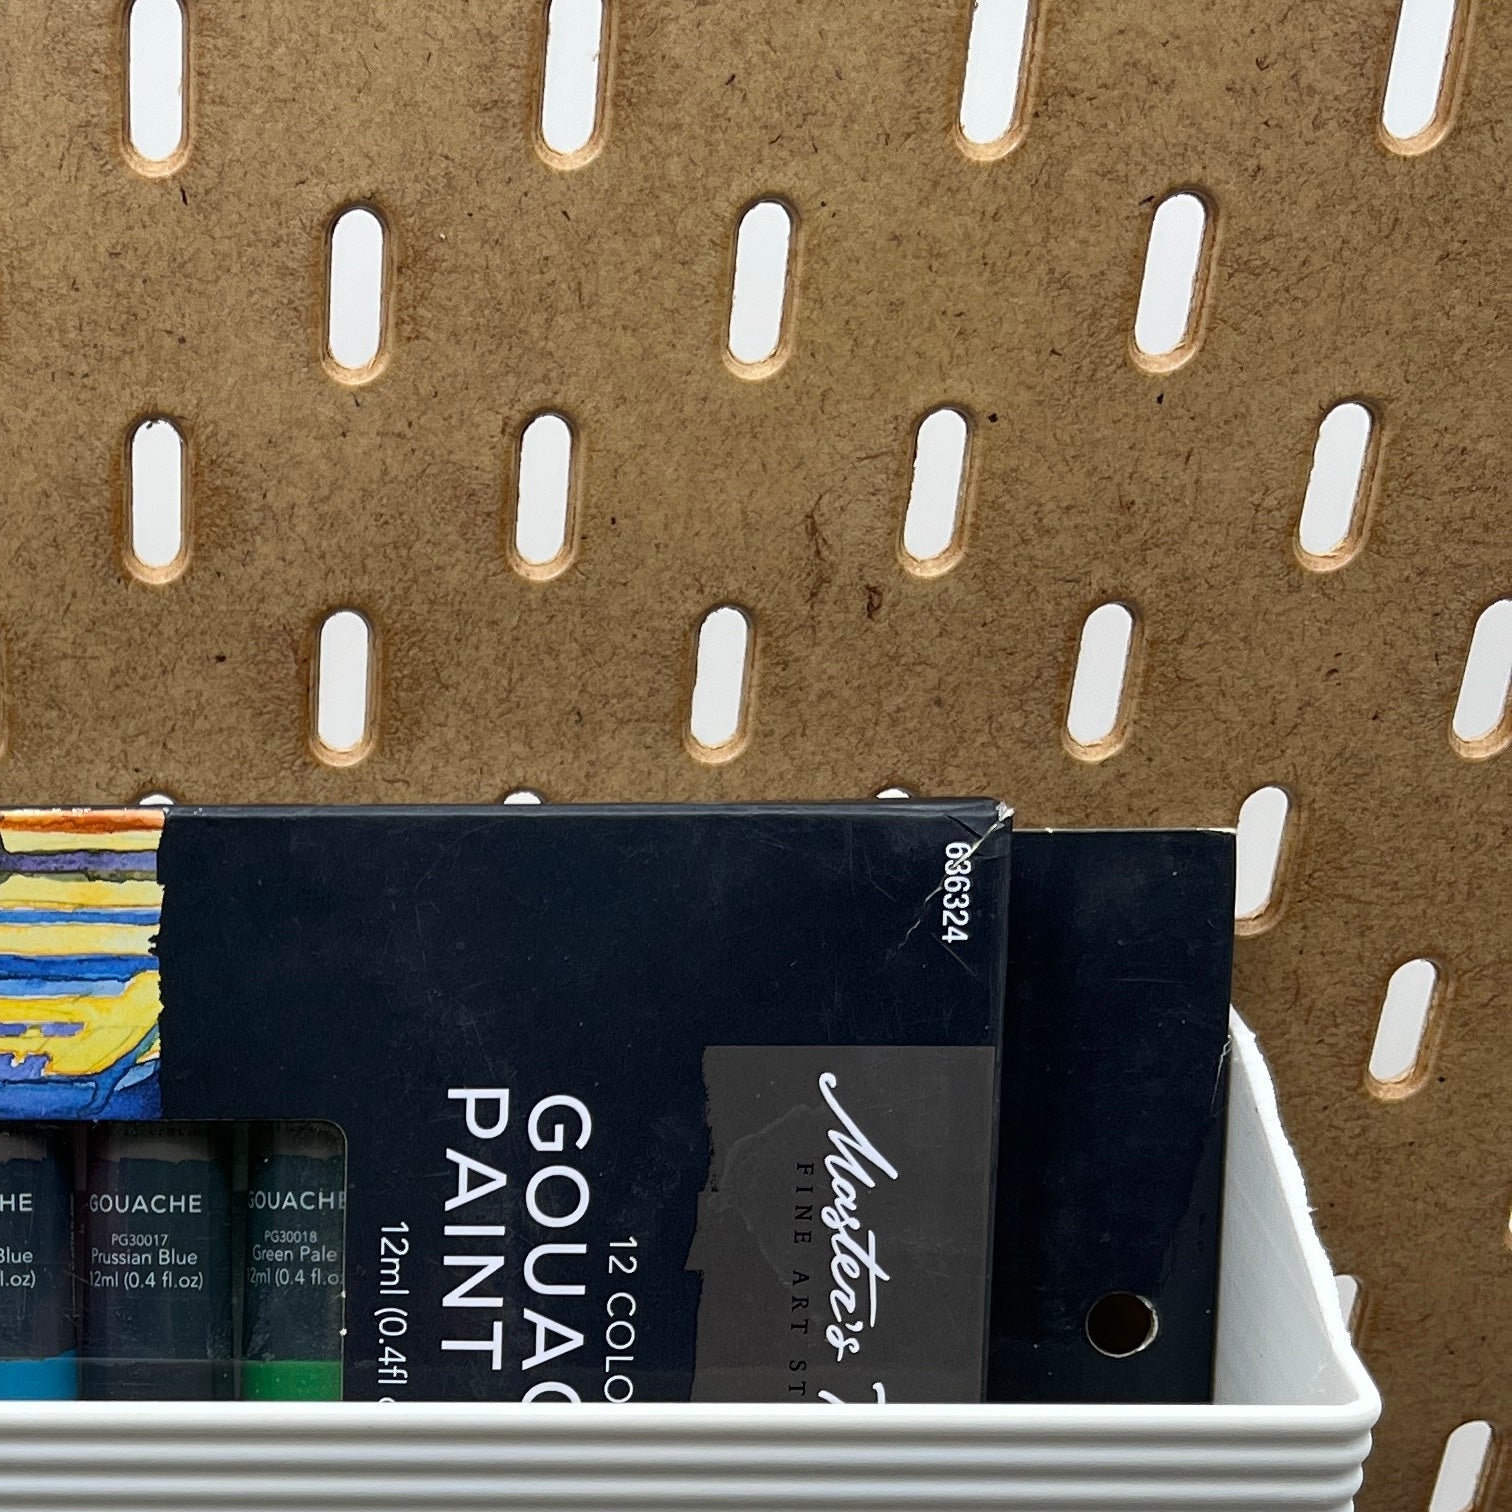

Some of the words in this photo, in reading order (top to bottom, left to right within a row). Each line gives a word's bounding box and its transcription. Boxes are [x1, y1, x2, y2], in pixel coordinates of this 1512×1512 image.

[941, 841, 971, 944] 636324
[88, 1193, 202, 1214] GOUACHE
[794, 1162, 815, 1244] FINE
[819, 1072, 898, 1362] Master's
[111, 1232, 169, 1247] PG30017
[264, 1230, 318, 1243] PG30018
[441, 1087, 510, 1371] PAINT
[91, 1247, 152, 1266] Prussian
[158, 1247, 198, 1267] Blue
[252, 1244, 293, 1262] Green
[299, 1244, 337, 1262] Pale
[379, 1221, 410, 1295] 12ml
[608, 1236, 638, 1274] 12
[124, 1270, 156, 1291] (0.4
[161, 1270, 204, 1291] fl.oz)
[275, 1268, 306, 1287] (0.4
[311, 1268, 343, 1286] fl.o
[791, 1270, 810, 1334] ART
[373, 1306, 409, 1385] (0.4fl
